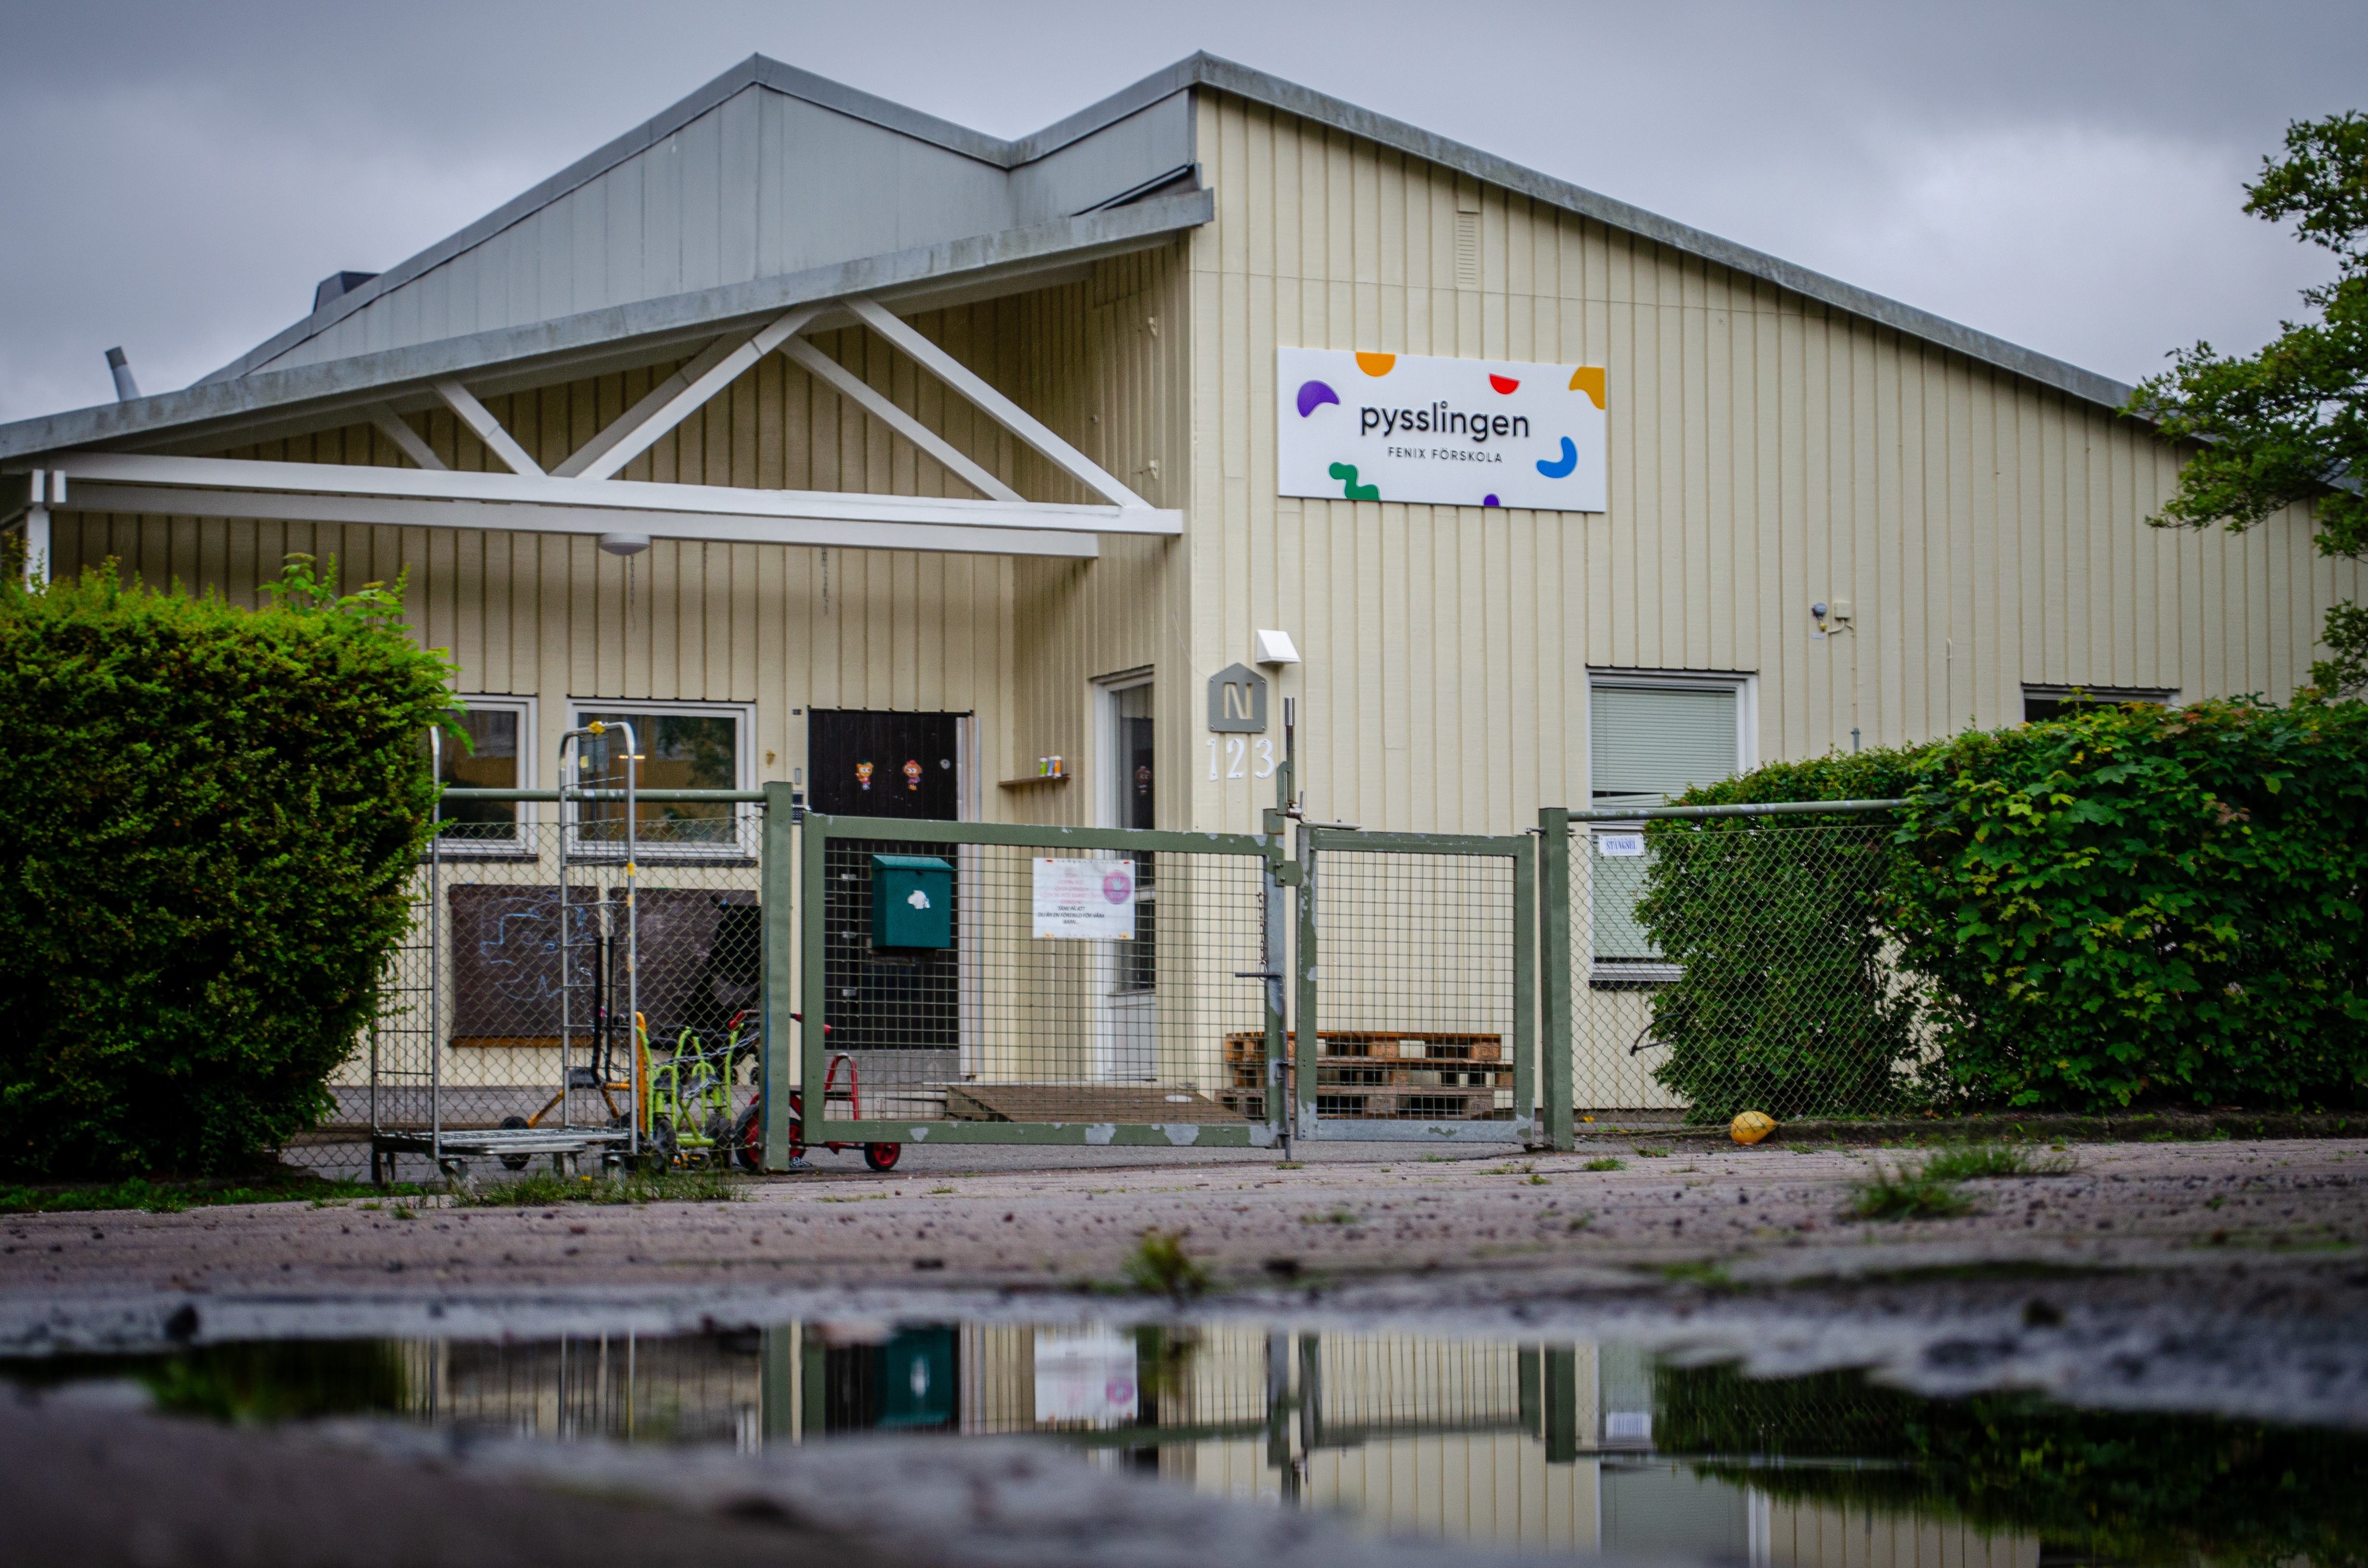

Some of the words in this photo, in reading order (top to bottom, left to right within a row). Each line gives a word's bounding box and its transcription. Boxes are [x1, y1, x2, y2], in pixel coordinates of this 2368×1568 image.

[1360, 401, 1530, 442] pysslingen
[1388, 446, 1426, 459] FENIX
[1432, 448, 1503, 463] FÖRSKOLA
[1222, 682, 1253, 720] N
[1207, 738, 1276, 782] 123
